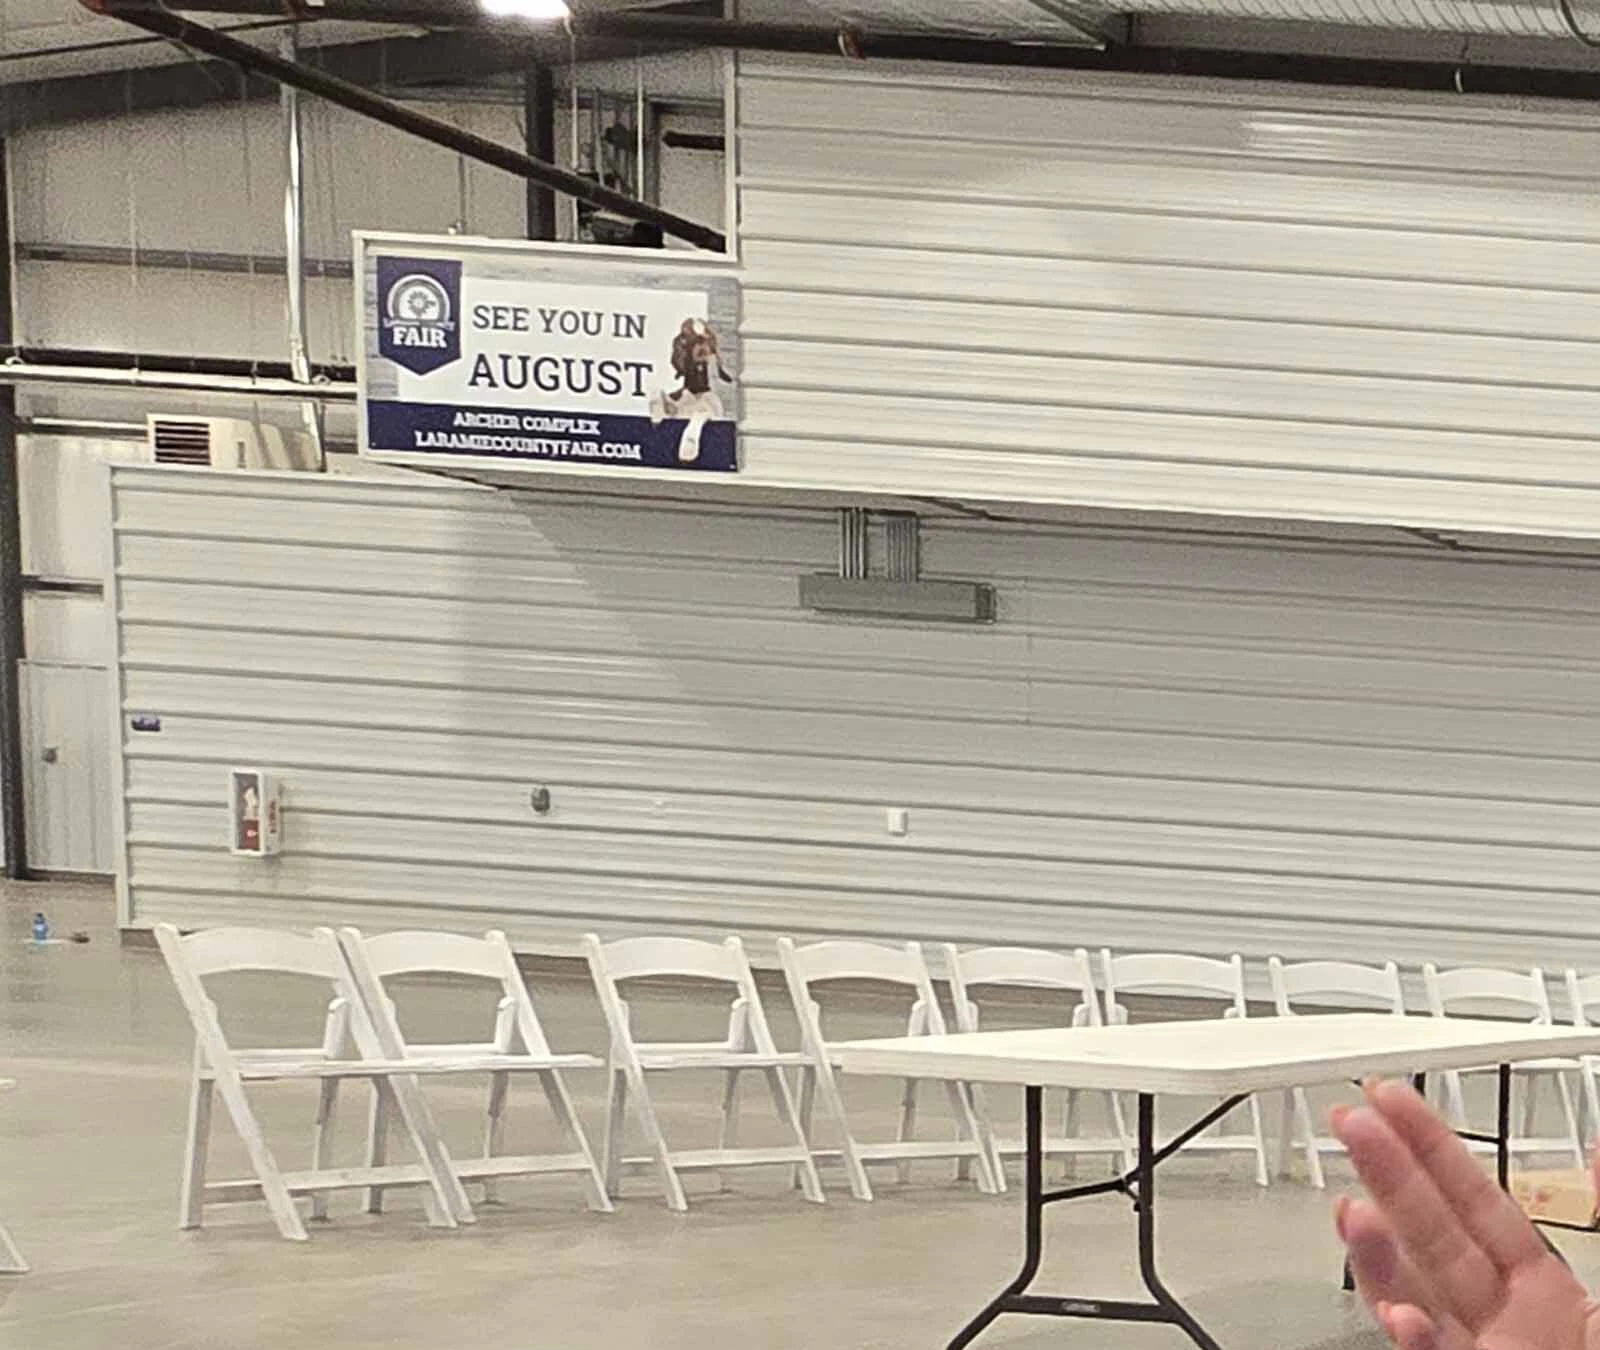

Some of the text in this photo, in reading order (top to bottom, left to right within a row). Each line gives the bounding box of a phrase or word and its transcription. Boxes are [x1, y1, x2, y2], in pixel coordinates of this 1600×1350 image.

[472, 304, 530, 332] SEE
[538, 308, 604, 337] YOU
[612, 312, 648, 339] IN
[391, 326, 448, 349] FAIR
[468, 352, 654, 397] AUGUST
[453, 411, 601, 435] ARCHER COMPLEX
[414, 430, 642, 460] LARAMIECOUNTYFAIR.COM
